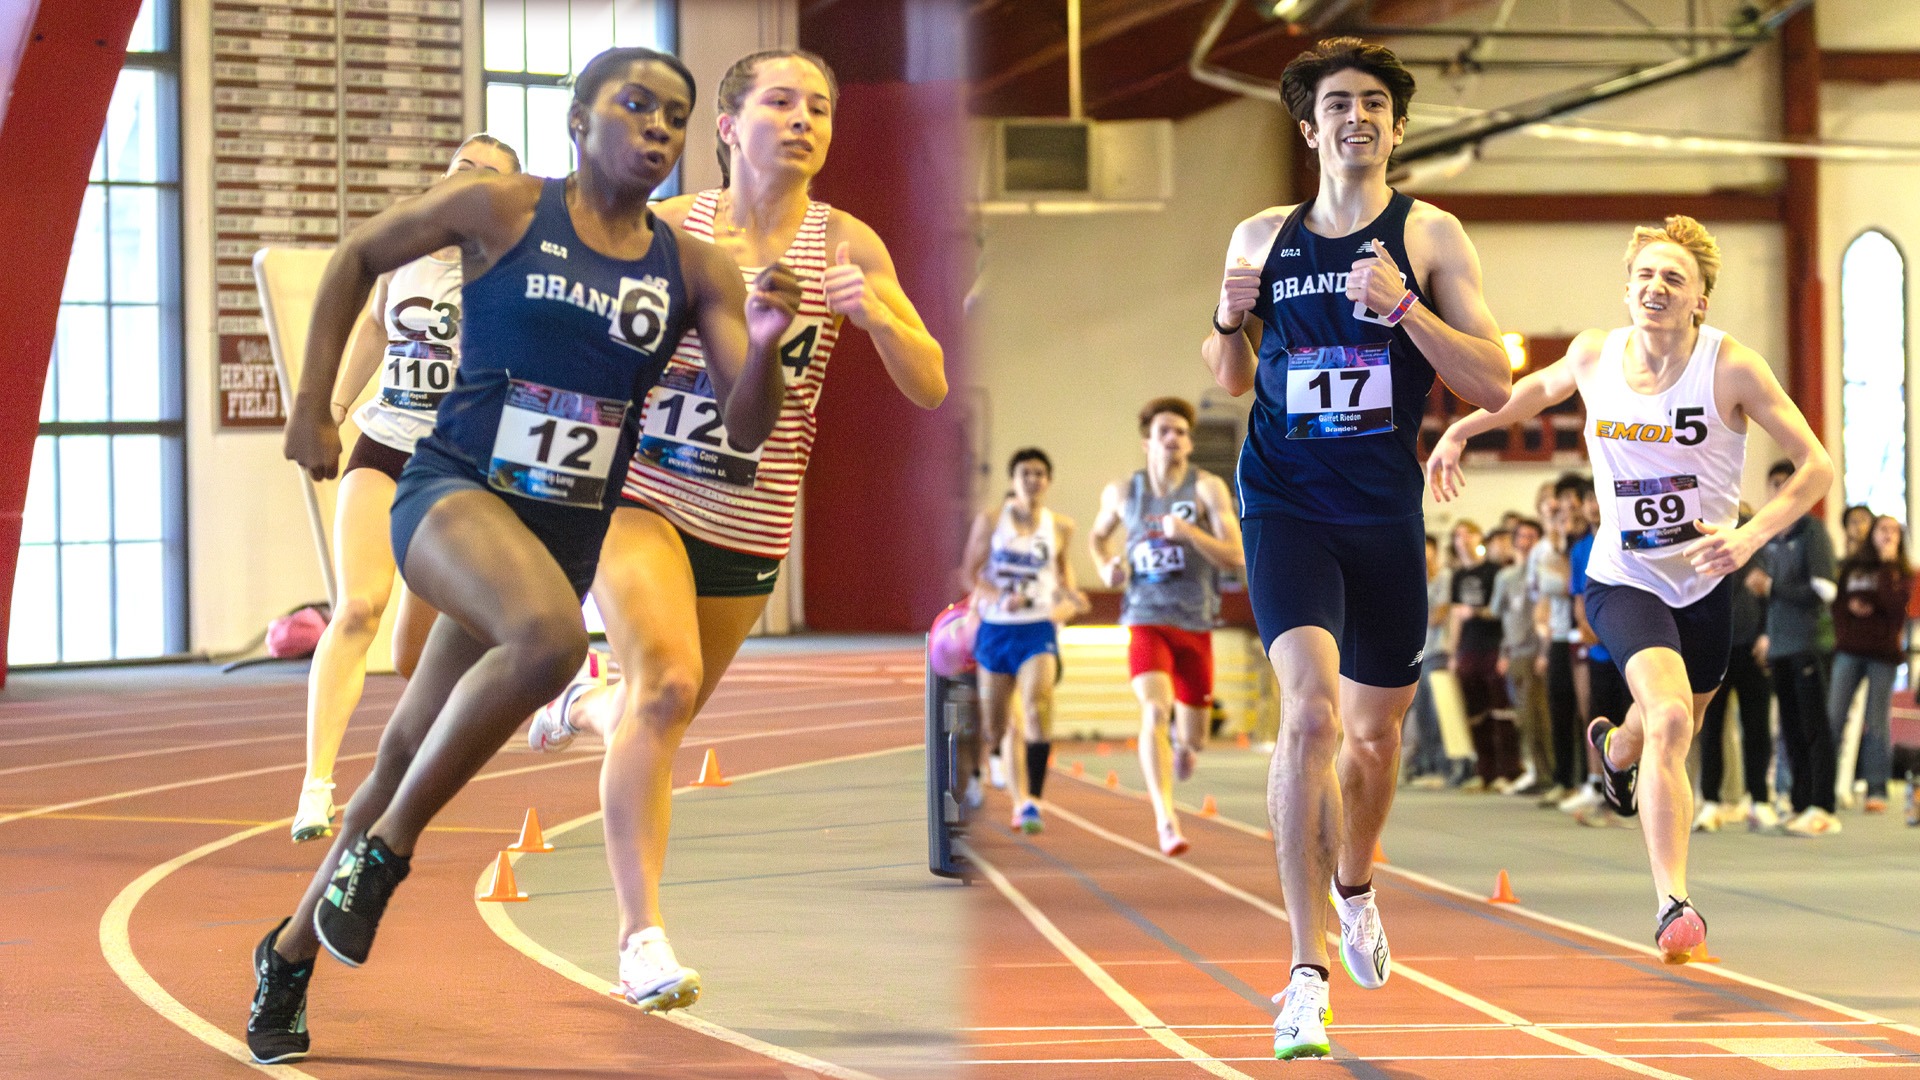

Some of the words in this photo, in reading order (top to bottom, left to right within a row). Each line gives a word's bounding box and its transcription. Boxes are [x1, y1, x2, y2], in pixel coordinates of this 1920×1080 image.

[1281, 249, 1301, 257] UAA
[428, 302, 460, 340] 3
[619, 288, 665, 347] 6
[781, 325, 818, 377] 4
[388, 358, 449, 390] 110
[1309, 369, 1371, 409] 17
[528, 419, 598, 471] 12
[1674, 406, 1708, 446] 5
[1634, 494, 1685, 527] 69
[1142, 548, 1180, 569] 124
